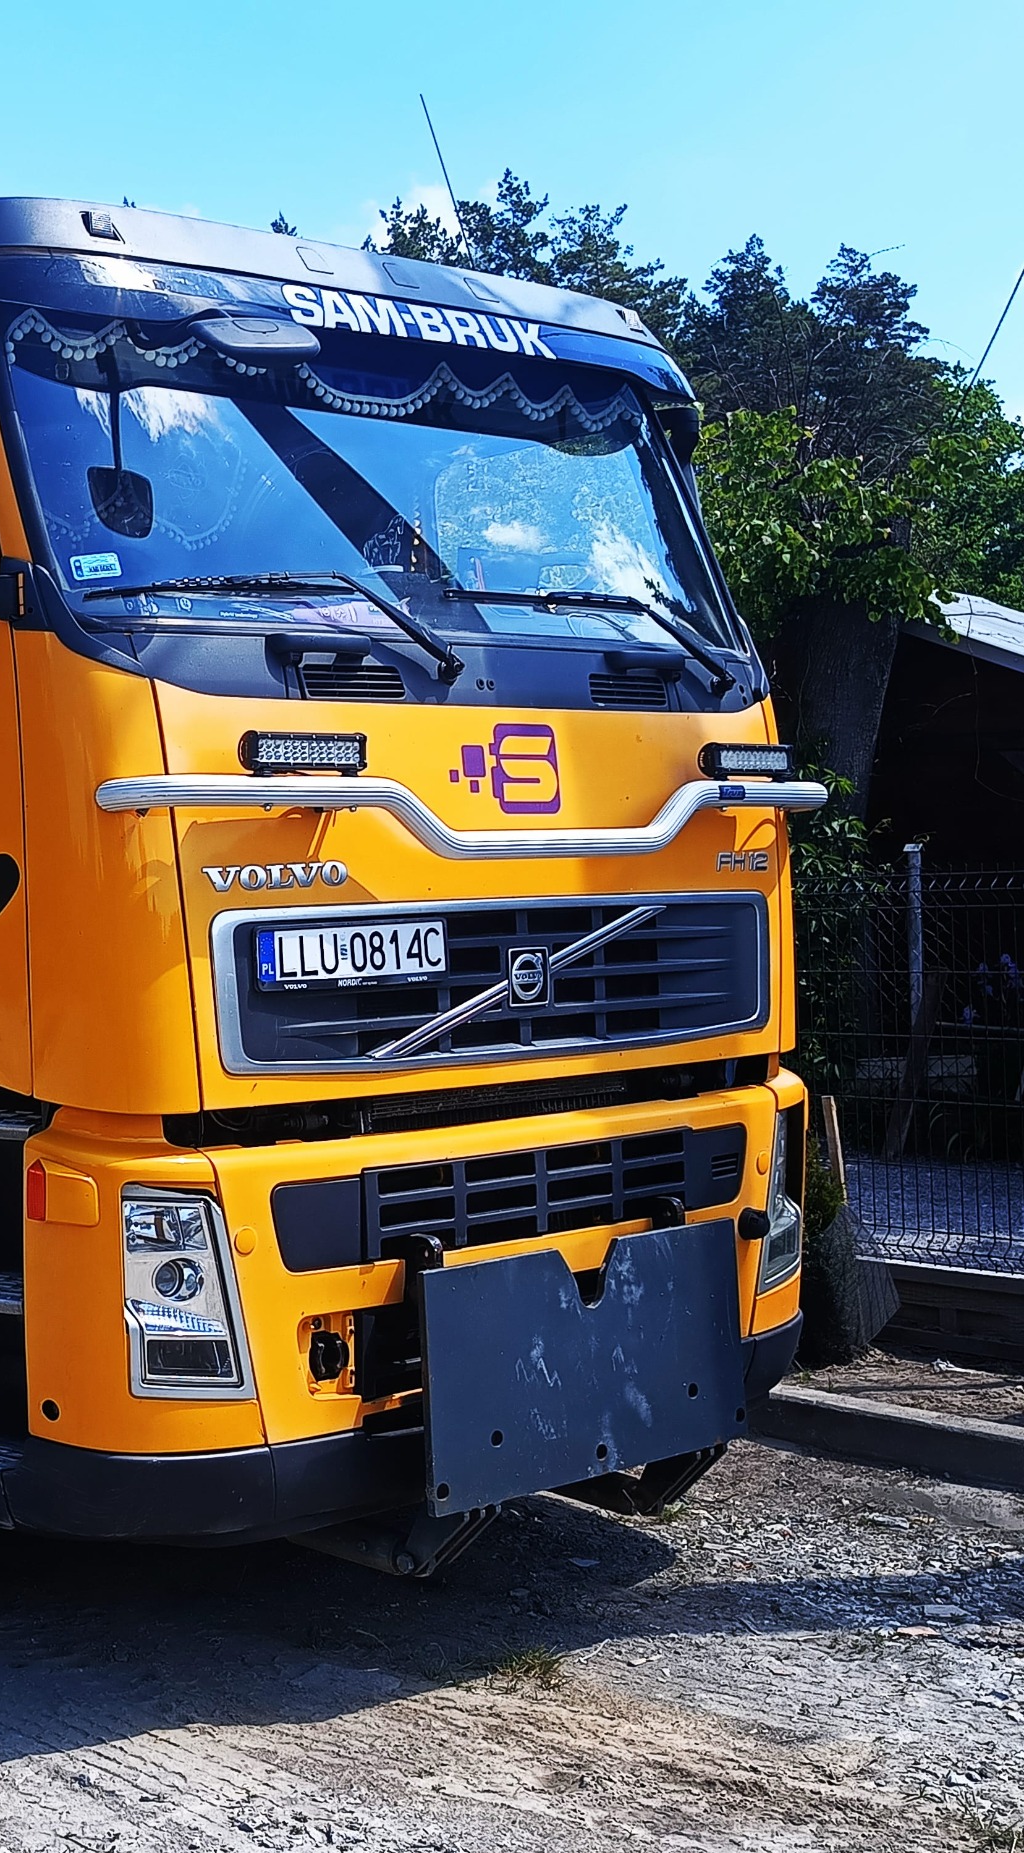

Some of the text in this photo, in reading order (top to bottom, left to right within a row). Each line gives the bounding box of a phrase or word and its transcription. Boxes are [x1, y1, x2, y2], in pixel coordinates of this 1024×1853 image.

[281, 283, 558, 360] SAM-BRUK
[202, 860, 348, 892] VOLVO
[261, 963, 275, 976] PL
[337, 978, 363, 987] NORDIC
[406, 975, 428, 983] VOLVO
